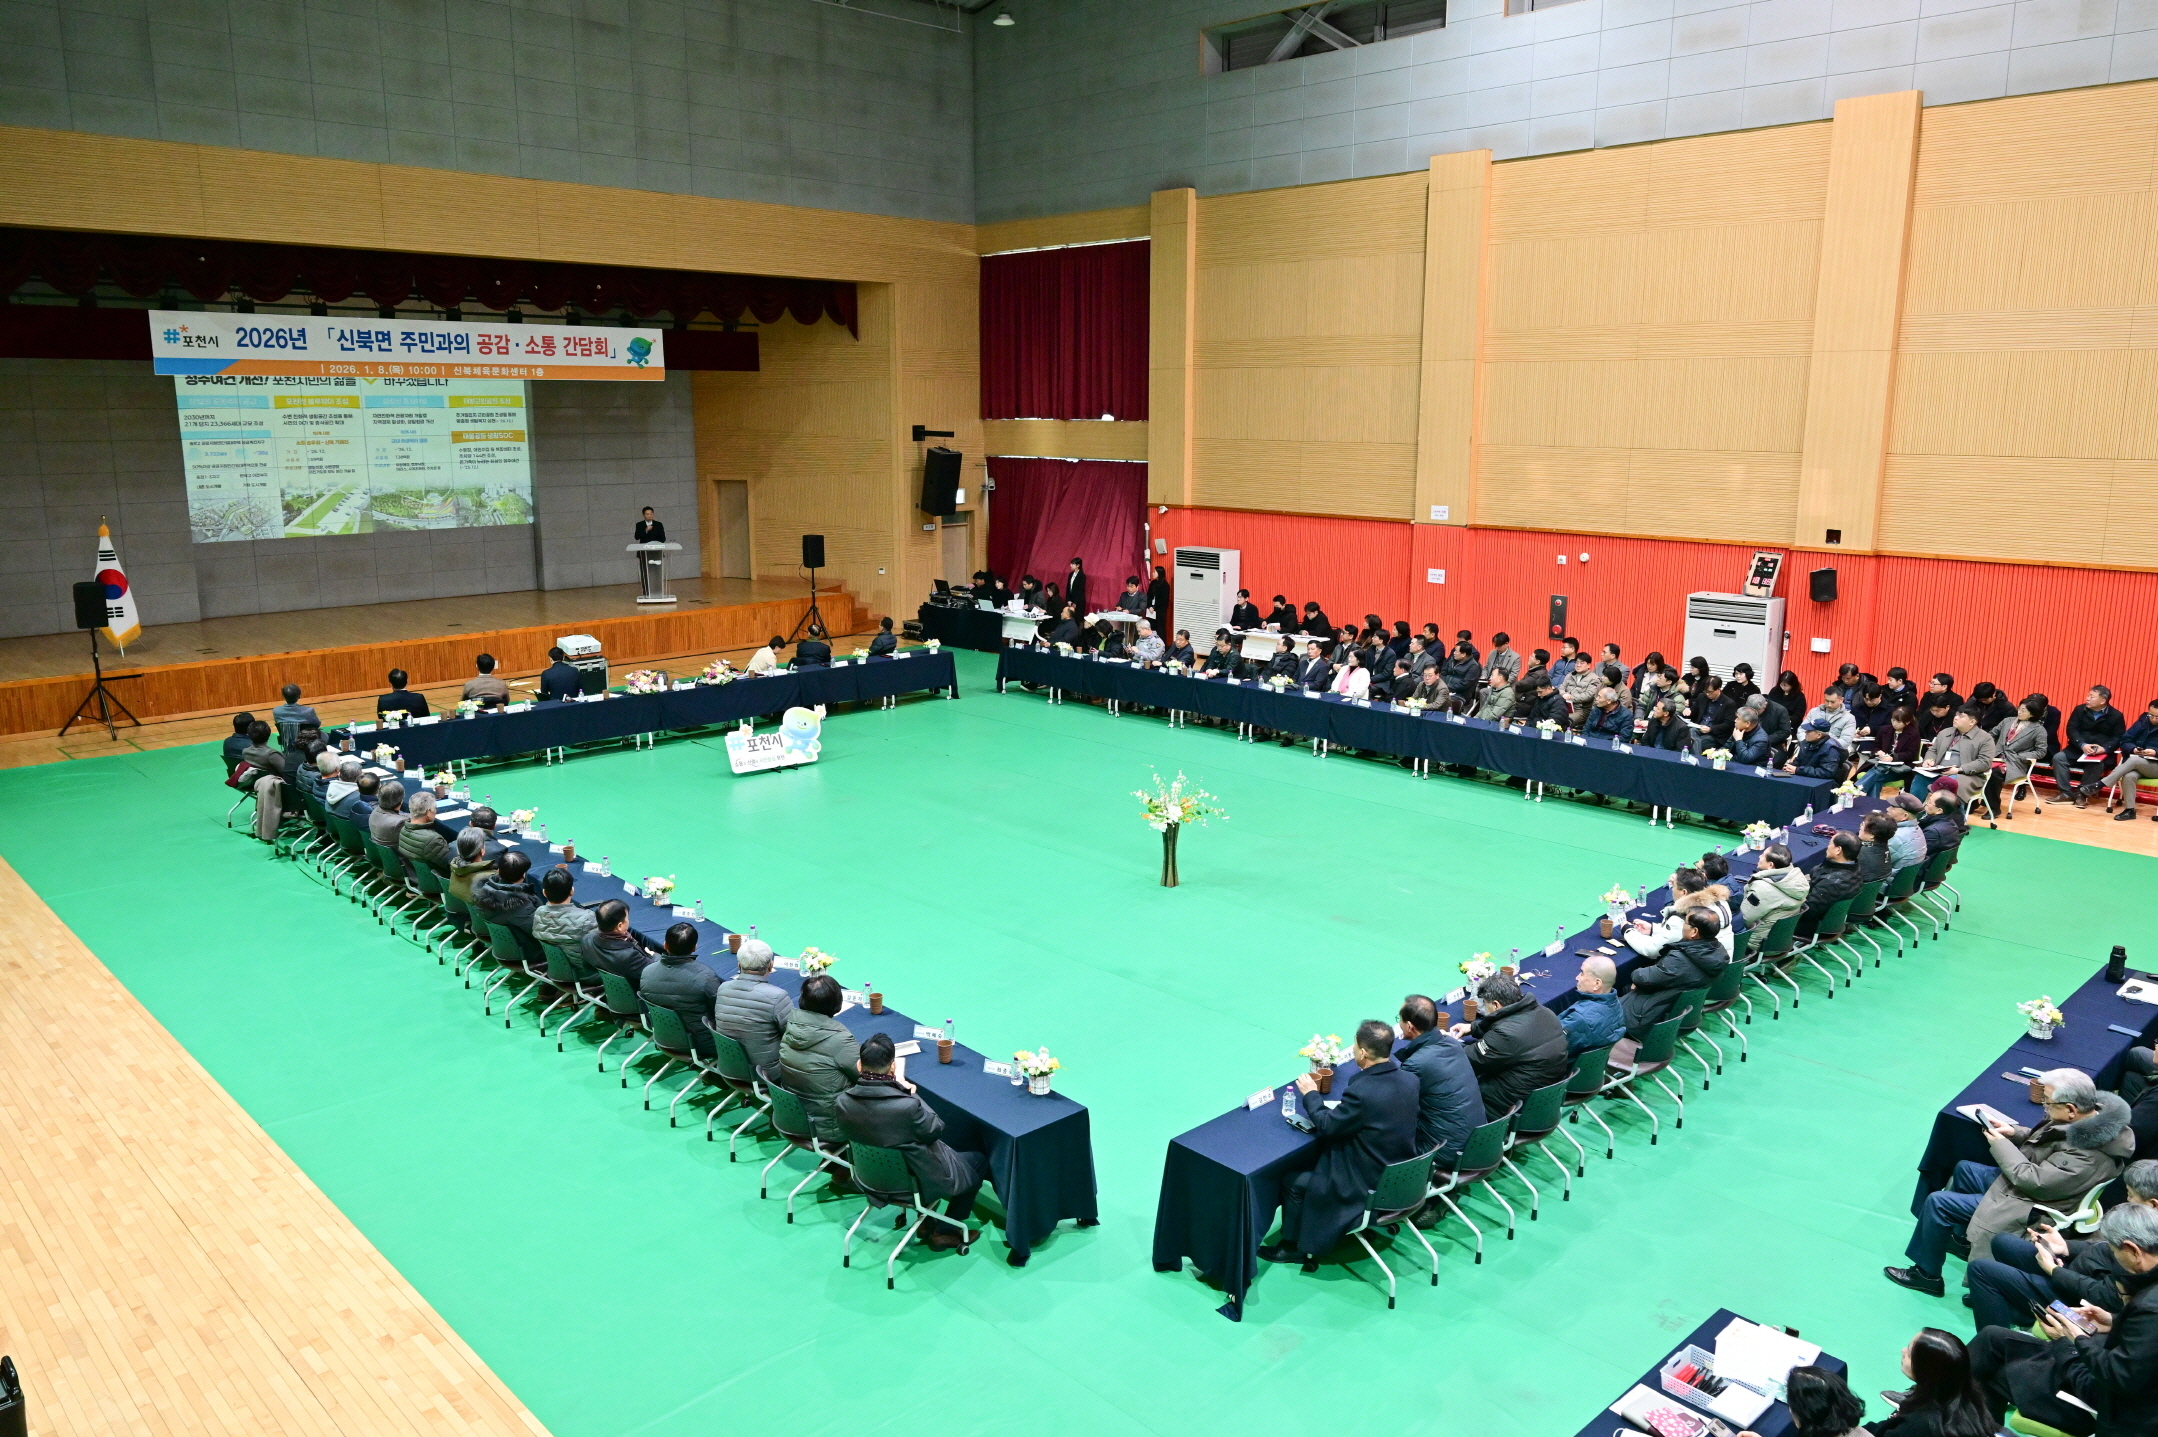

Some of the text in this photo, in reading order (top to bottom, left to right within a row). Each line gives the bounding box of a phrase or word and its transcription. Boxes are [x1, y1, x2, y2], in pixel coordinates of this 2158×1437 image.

[182, 335, 219, 348] 포천시
[235, 326, 308, 350] 2026년
[400, 331, 470, 354] 주민과의
[476, 333, 510, 355] 공감
[525, 334, 557, 356] 소통
[329, 365, 360, 374] 2026.
[408, 366, 437, 375] 10:00
[453, 366, 527, 376] 신북체육문화센터
[531, 367, 545, 377] 1층
[746, 734, 783, 752] 포천시
